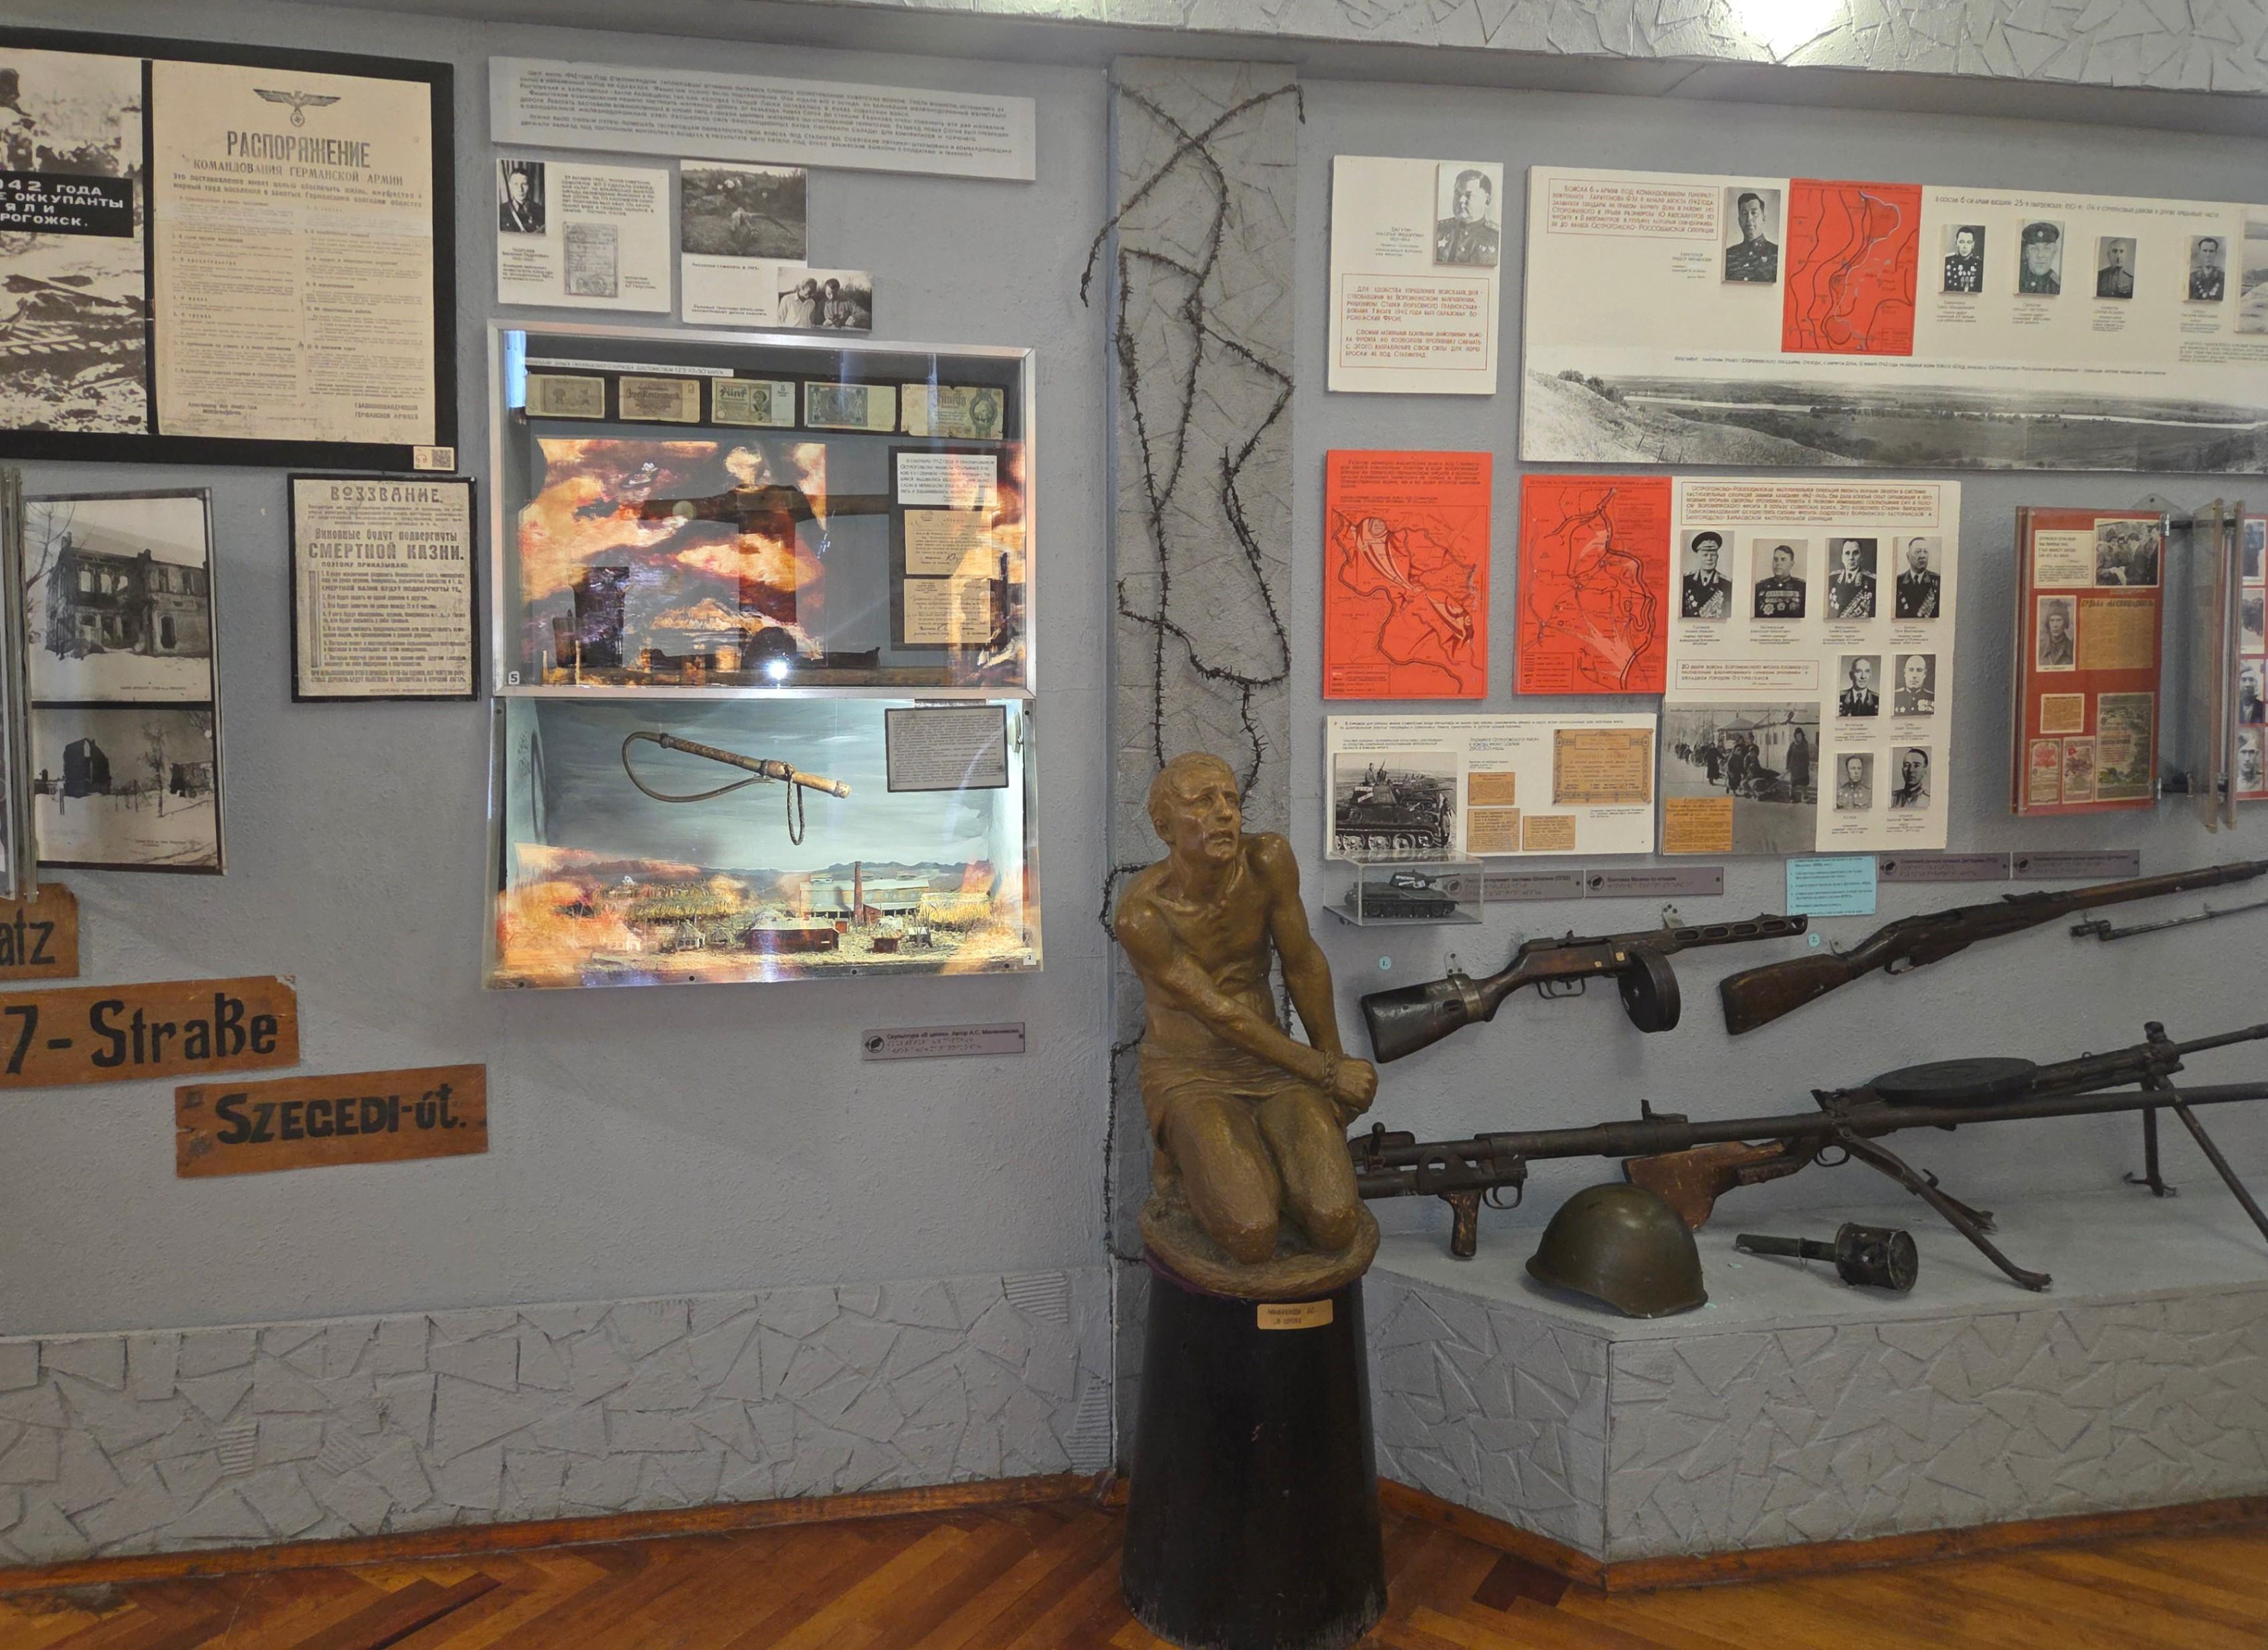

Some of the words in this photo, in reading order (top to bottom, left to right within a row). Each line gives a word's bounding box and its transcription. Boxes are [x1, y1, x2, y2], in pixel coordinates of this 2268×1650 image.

[227, 130, 371, 168] РАСПОРЯЖЕНИЕ
[193, 159, 282, 176] КОМАНДОВАНИЯ
[290, 165, 359, 182] ГЕРМАНСКОЙ
[367, 174, 403, 186] АРМИИ
[57, 184, 102, 195] ГОДА
[15, 193, 123, 208] ОККУПАНТЫ
[719, 385, 748, 398] Fünf
[330, 486, 443, 502] ВОЗЗВАНИЕ.
[315, 528, 361, 541] Виновные
[366, 528, 393, 543] будут
[399, 531, 458, 542] подвергнуты
[308, 541, 396, 559] СМЕРТНОЙ
[407, 545, 464, 561] КАЗНИ.
[510, 674, 517, 682] 5
